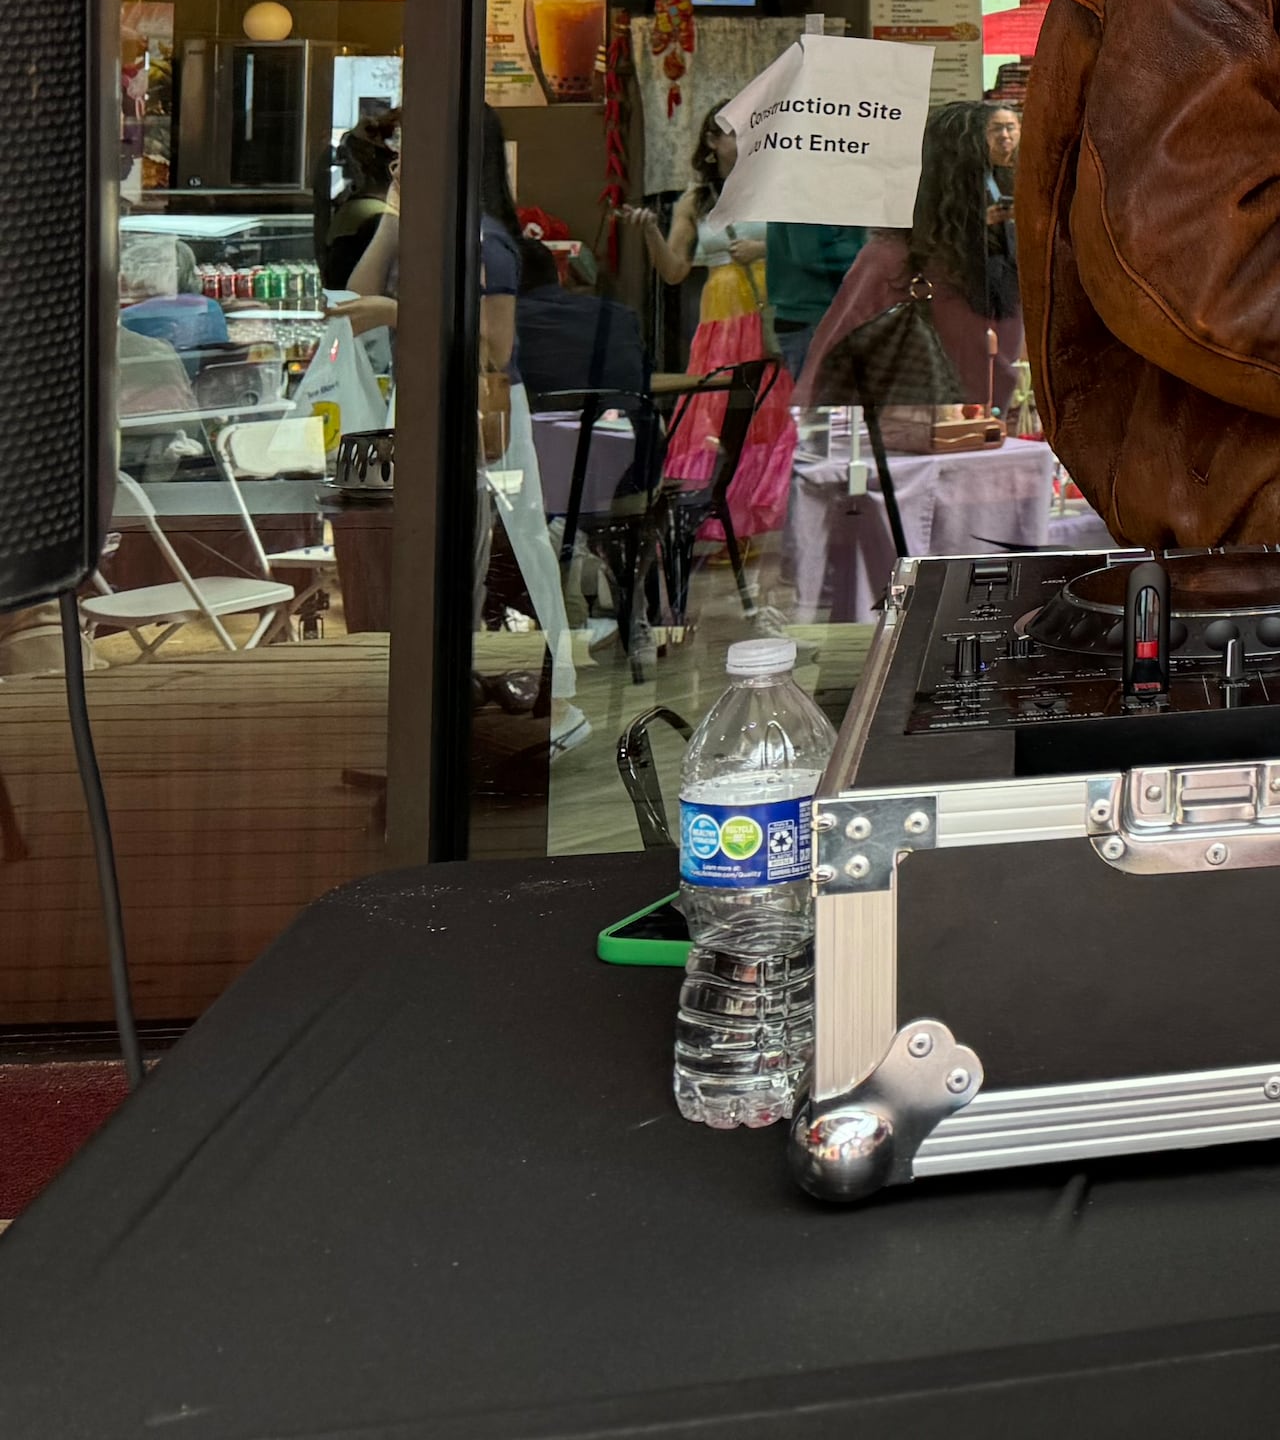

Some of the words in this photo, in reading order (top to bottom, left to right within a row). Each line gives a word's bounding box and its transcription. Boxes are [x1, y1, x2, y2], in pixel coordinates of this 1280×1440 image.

[749, 97, 852, 129] Construction
[857, 100, 903, 121] Site
[763, 131, 803, 151] Not
[809, 133, 870, 155] Enter
